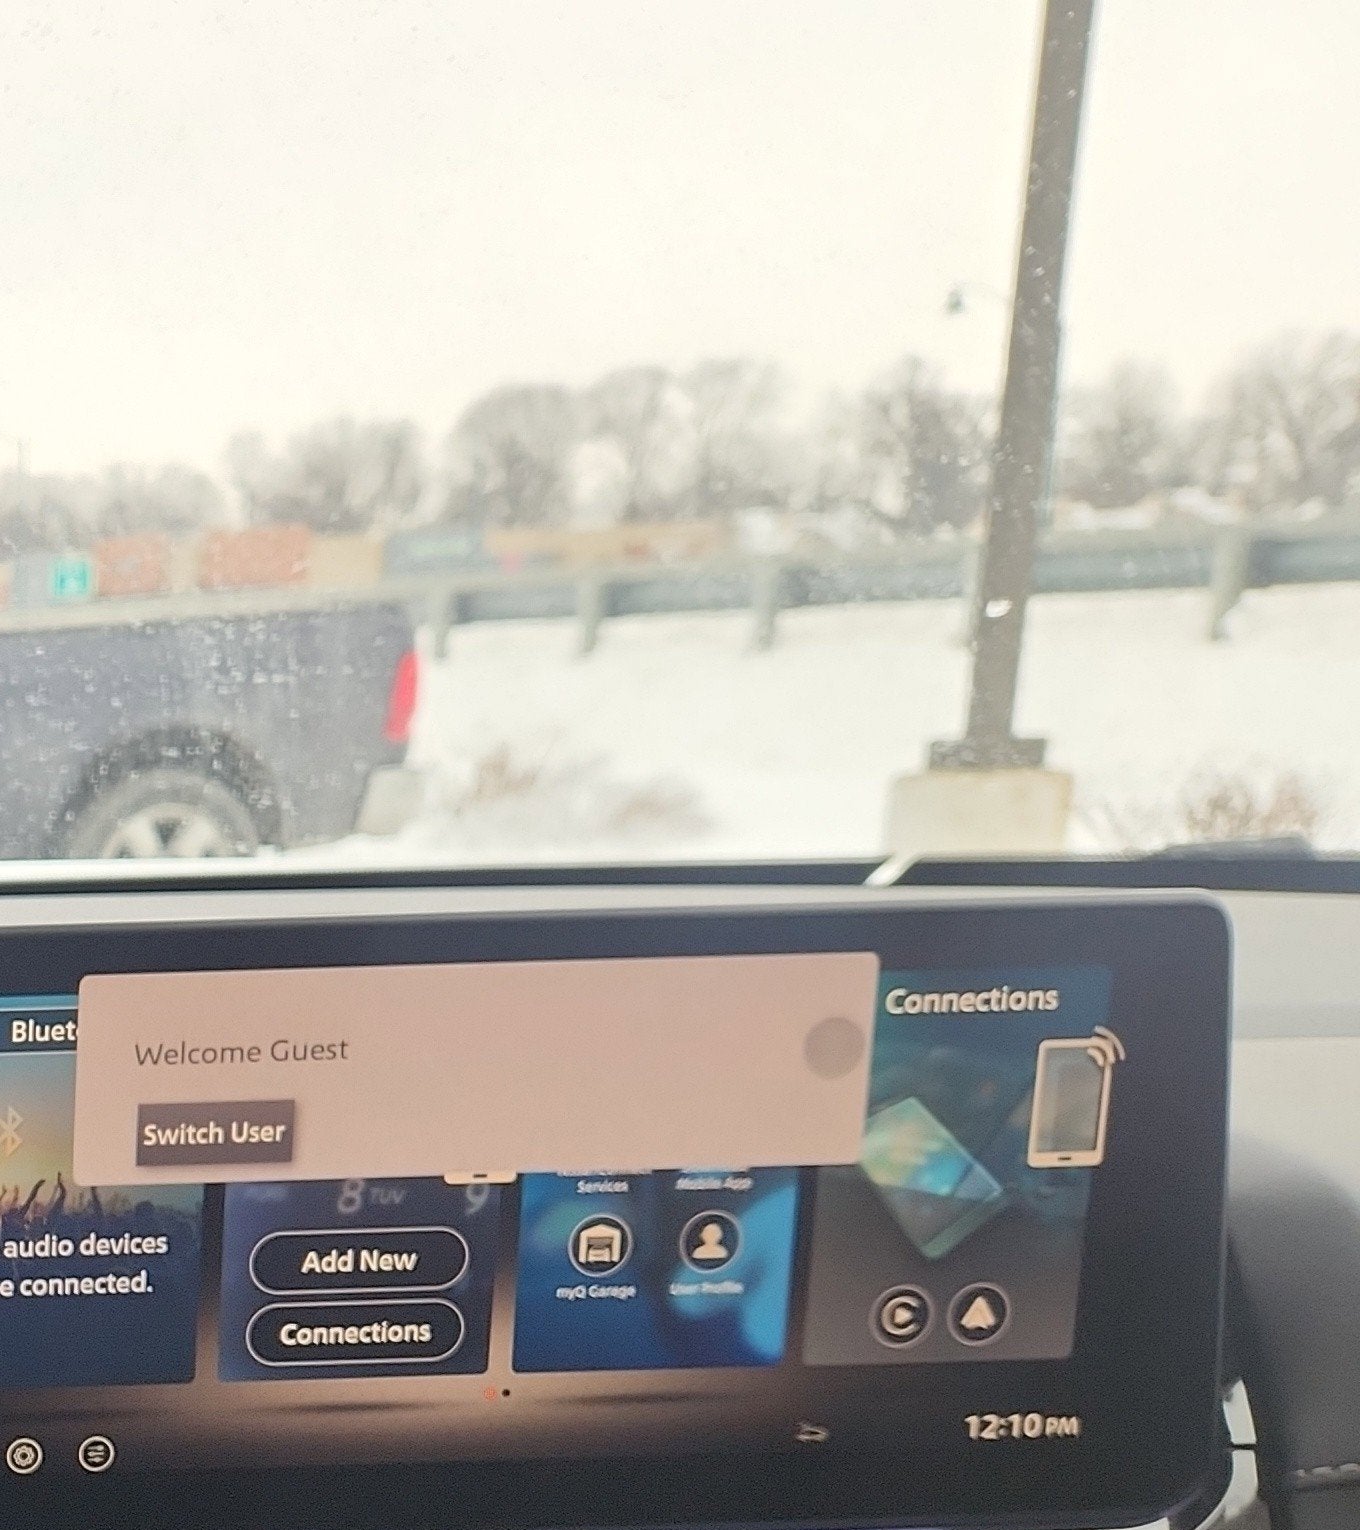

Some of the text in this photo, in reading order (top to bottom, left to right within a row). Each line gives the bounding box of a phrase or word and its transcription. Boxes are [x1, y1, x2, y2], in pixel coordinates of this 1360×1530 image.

[885, 986, 1059, 1015] Connections
[12, 1018, 78, 1042] Bluet
[134, 1038, 350, 1066] Welcome Guest
[143, 1121, 286, 1146] Switch User
[3, 1233, 73, 1258] audio
[80, 1232, 169, 1257] devices
[301, 1249, 418, 1274] Add New
[19, 1270, 154, 1296] connected.
[280, 1320, 432, 1347] Connections
[964, 1413, 1043, 1439] 12:10
